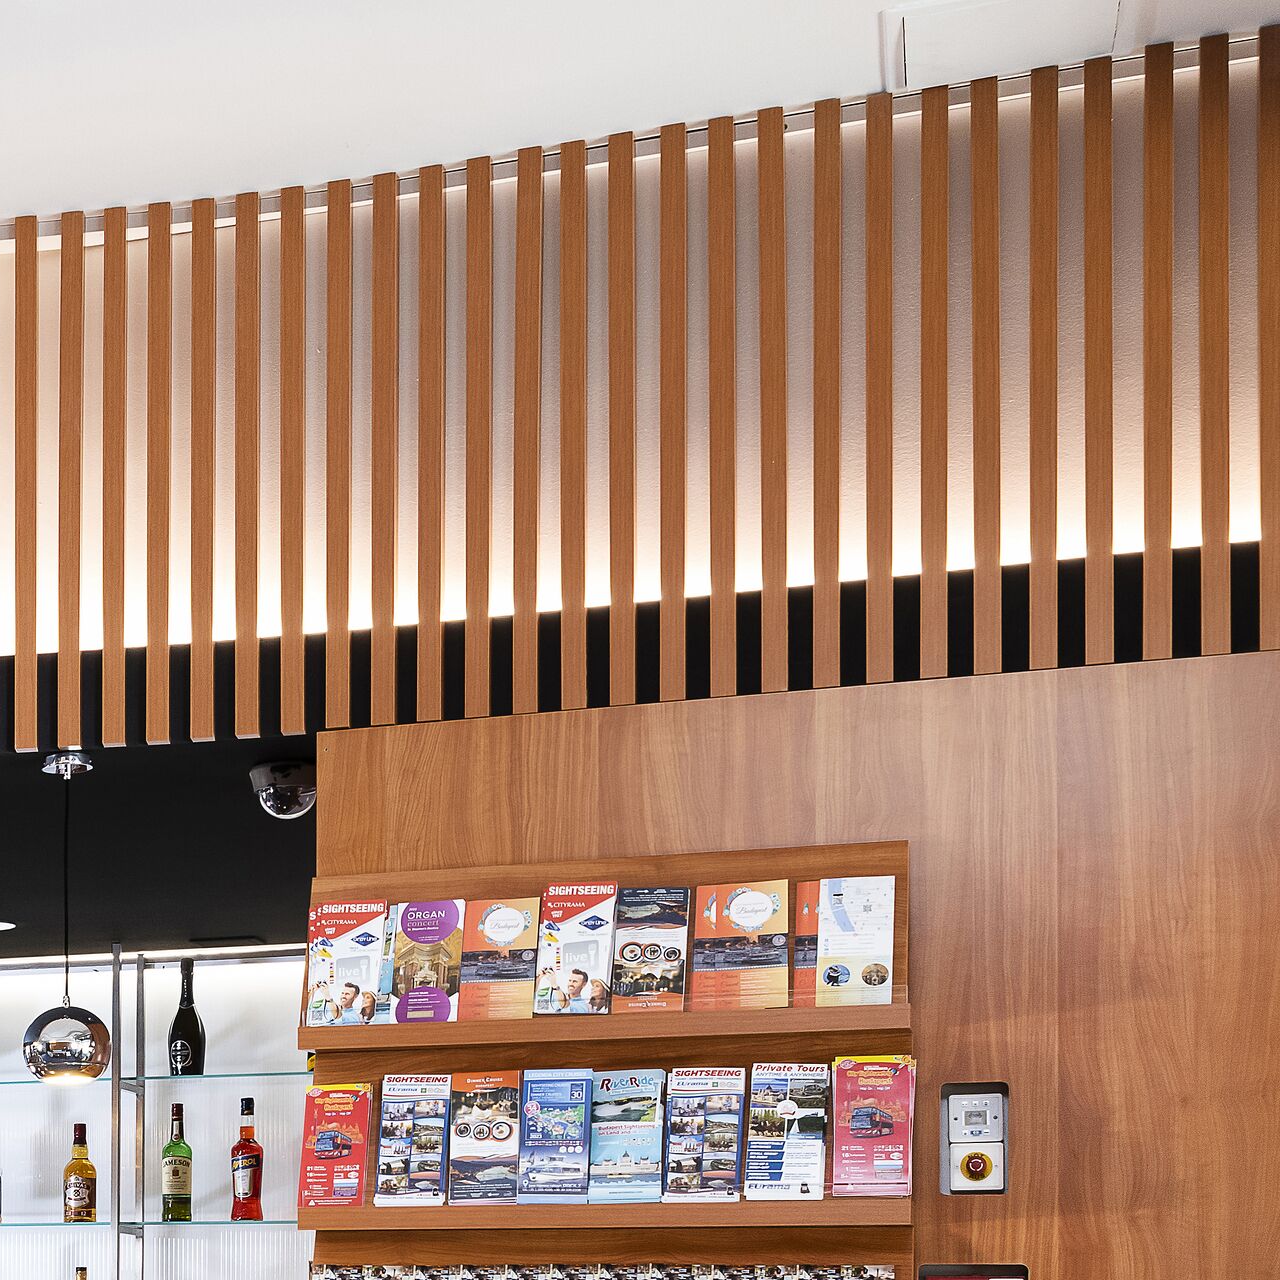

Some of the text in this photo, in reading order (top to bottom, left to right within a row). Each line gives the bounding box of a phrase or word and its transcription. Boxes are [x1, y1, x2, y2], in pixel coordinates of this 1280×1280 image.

[548, 885, 614, 896] SIGHTSEEING
[322, 903, 385, 914] SIGHTSEEING
[408, 910, 445, 920] ORGAN
[755, 1064, 793, 1072] Private
[600, 1076, 654, 1092] RiverRide
[571, 1091, 583, 1099] 30
